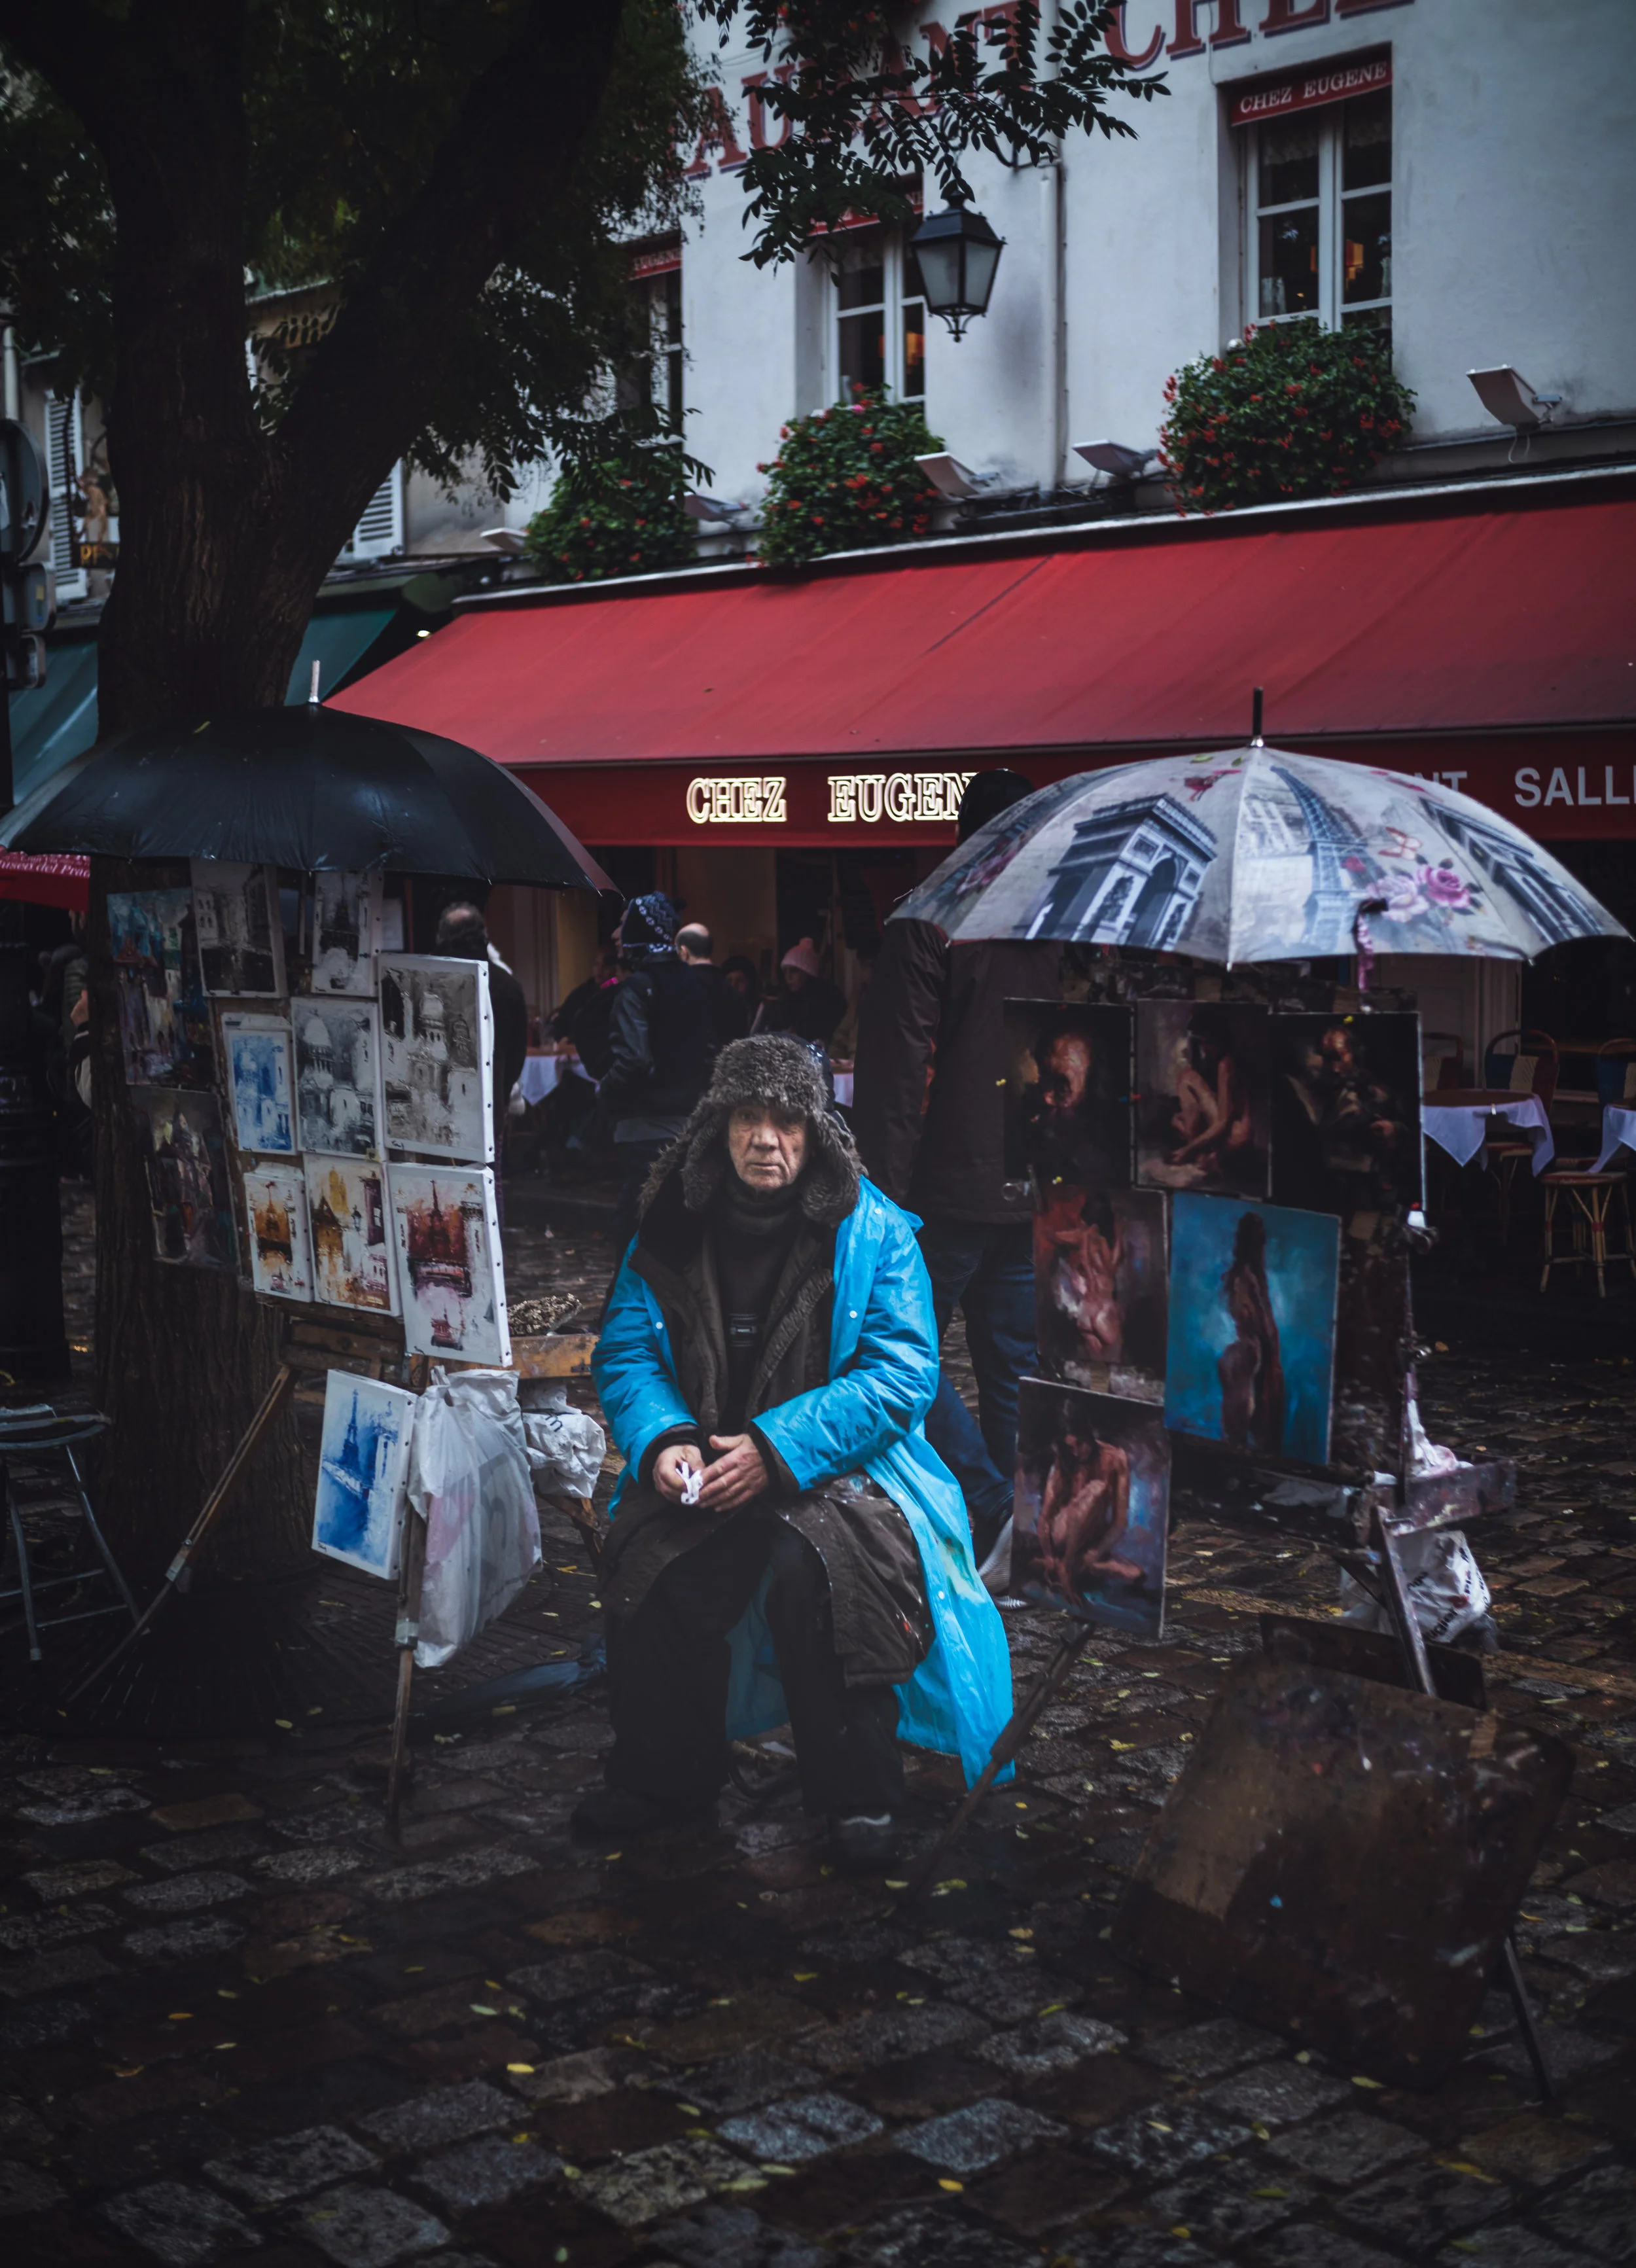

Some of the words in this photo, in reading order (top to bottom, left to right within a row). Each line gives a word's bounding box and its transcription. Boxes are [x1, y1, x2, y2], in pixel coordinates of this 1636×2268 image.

[1240, 86, 1293, 113] CHEZ
[1304, 61, 1387, 99] EUGENE
[686, 776, 787, 824] CHEZ
[1514, 765, 1636, 807] SALL
